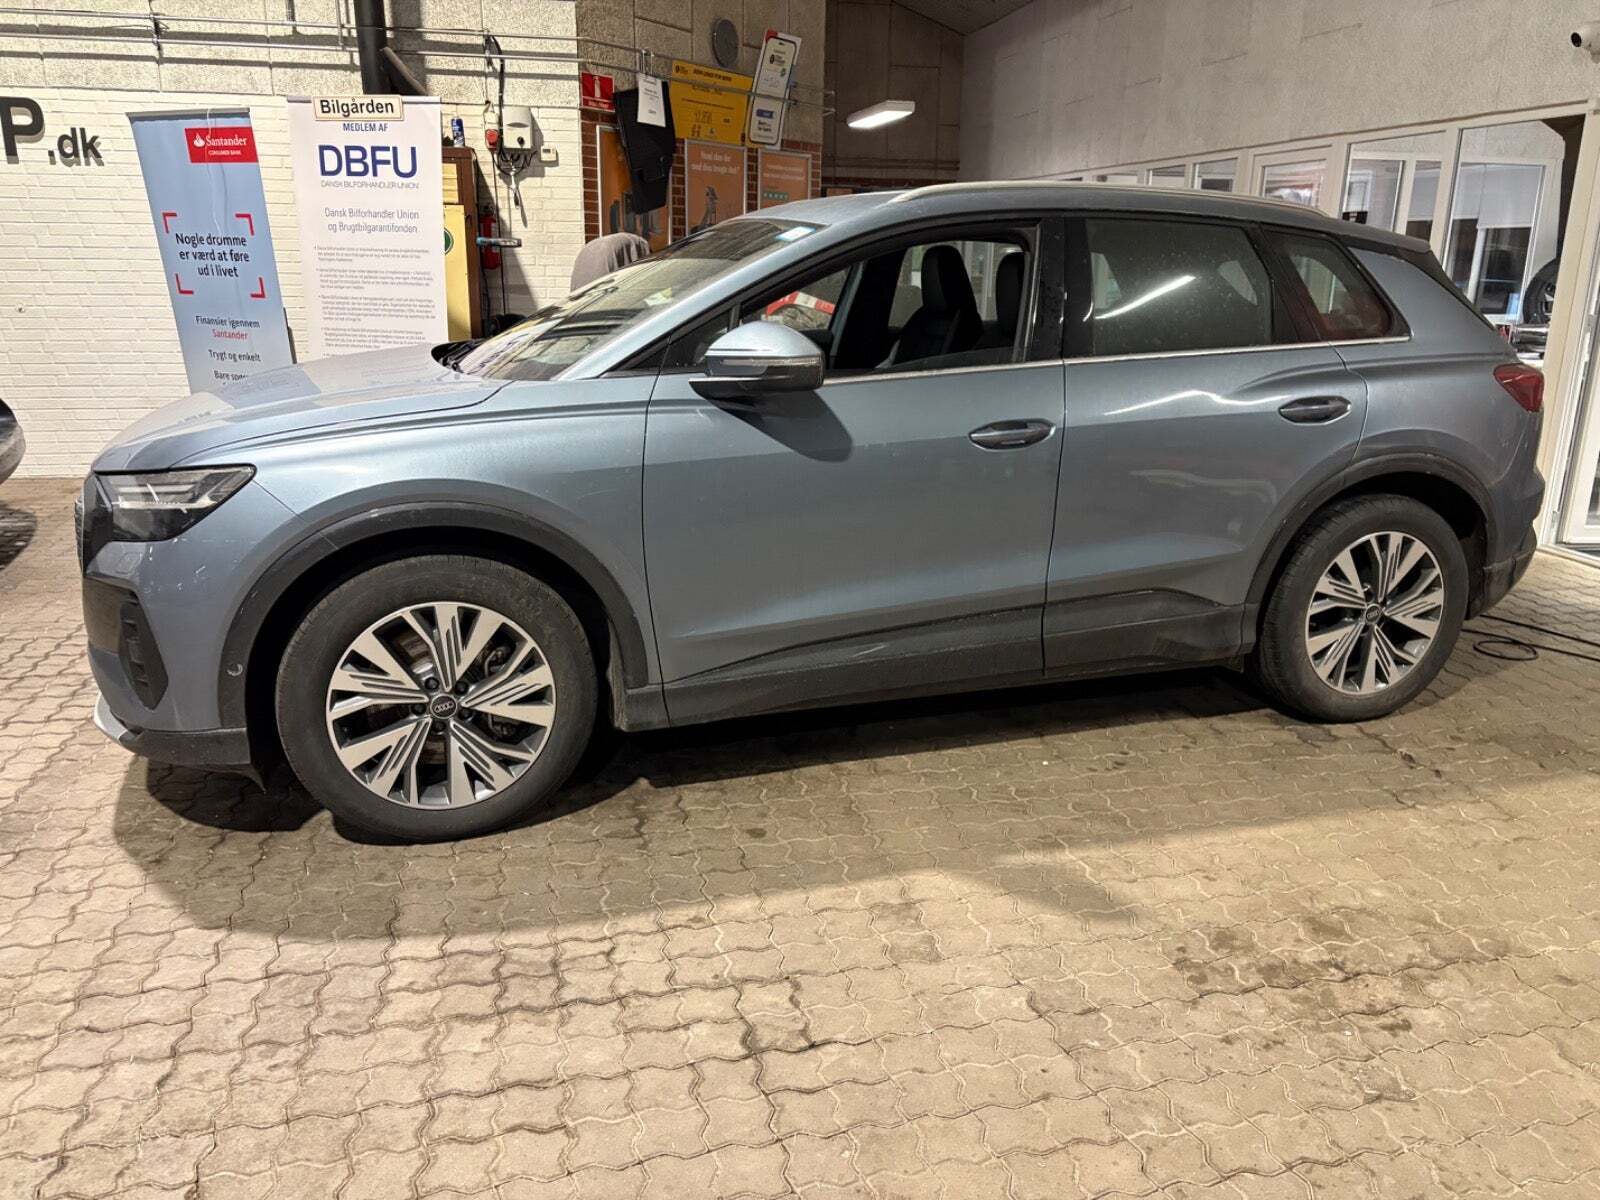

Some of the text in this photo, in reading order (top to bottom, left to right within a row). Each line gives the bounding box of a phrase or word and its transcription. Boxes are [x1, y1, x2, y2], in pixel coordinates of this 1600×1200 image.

[320, 98, 394, 118] Bilgården
[343, 123, 389, 132] MEDLEM AF
[206, 133, 248, 147] Santander
[318, 144, 418, 179] DBFU
[324, 207, 420, 220] Dansk Bilforhandler Union
[327, 223, 338, 233] og
[175, 232, 205, 249] Nogle
[179, 248, 250, 263] er værd at føre
[197, 263, 239, 278] ud i livet
[228, 317, 261, 329] igennem
[211, 328, 248, 340] Santander
[208, 349, 228, 362] Trygt
[228, 352, 238, 363] og
